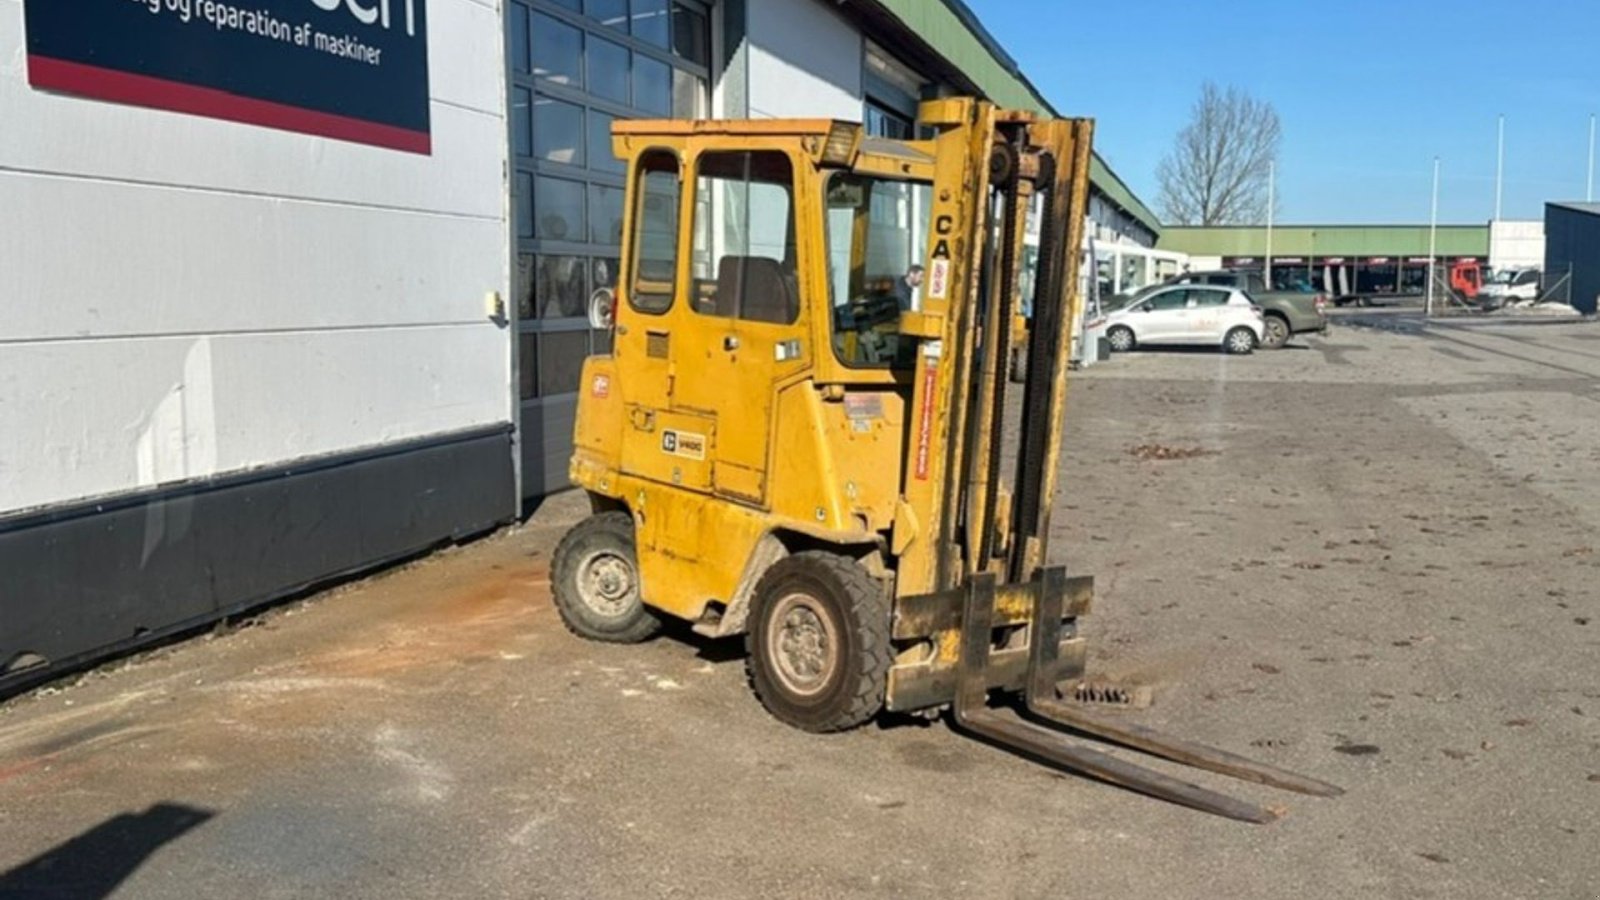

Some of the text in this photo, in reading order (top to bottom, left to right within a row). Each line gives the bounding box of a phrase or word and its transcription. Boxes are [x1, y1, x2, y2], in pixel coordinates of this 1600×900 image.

[196, 0, 291, 42] reparation
[294, 22, 311, 47] af
[314, 31, 381, 65] maskiner
